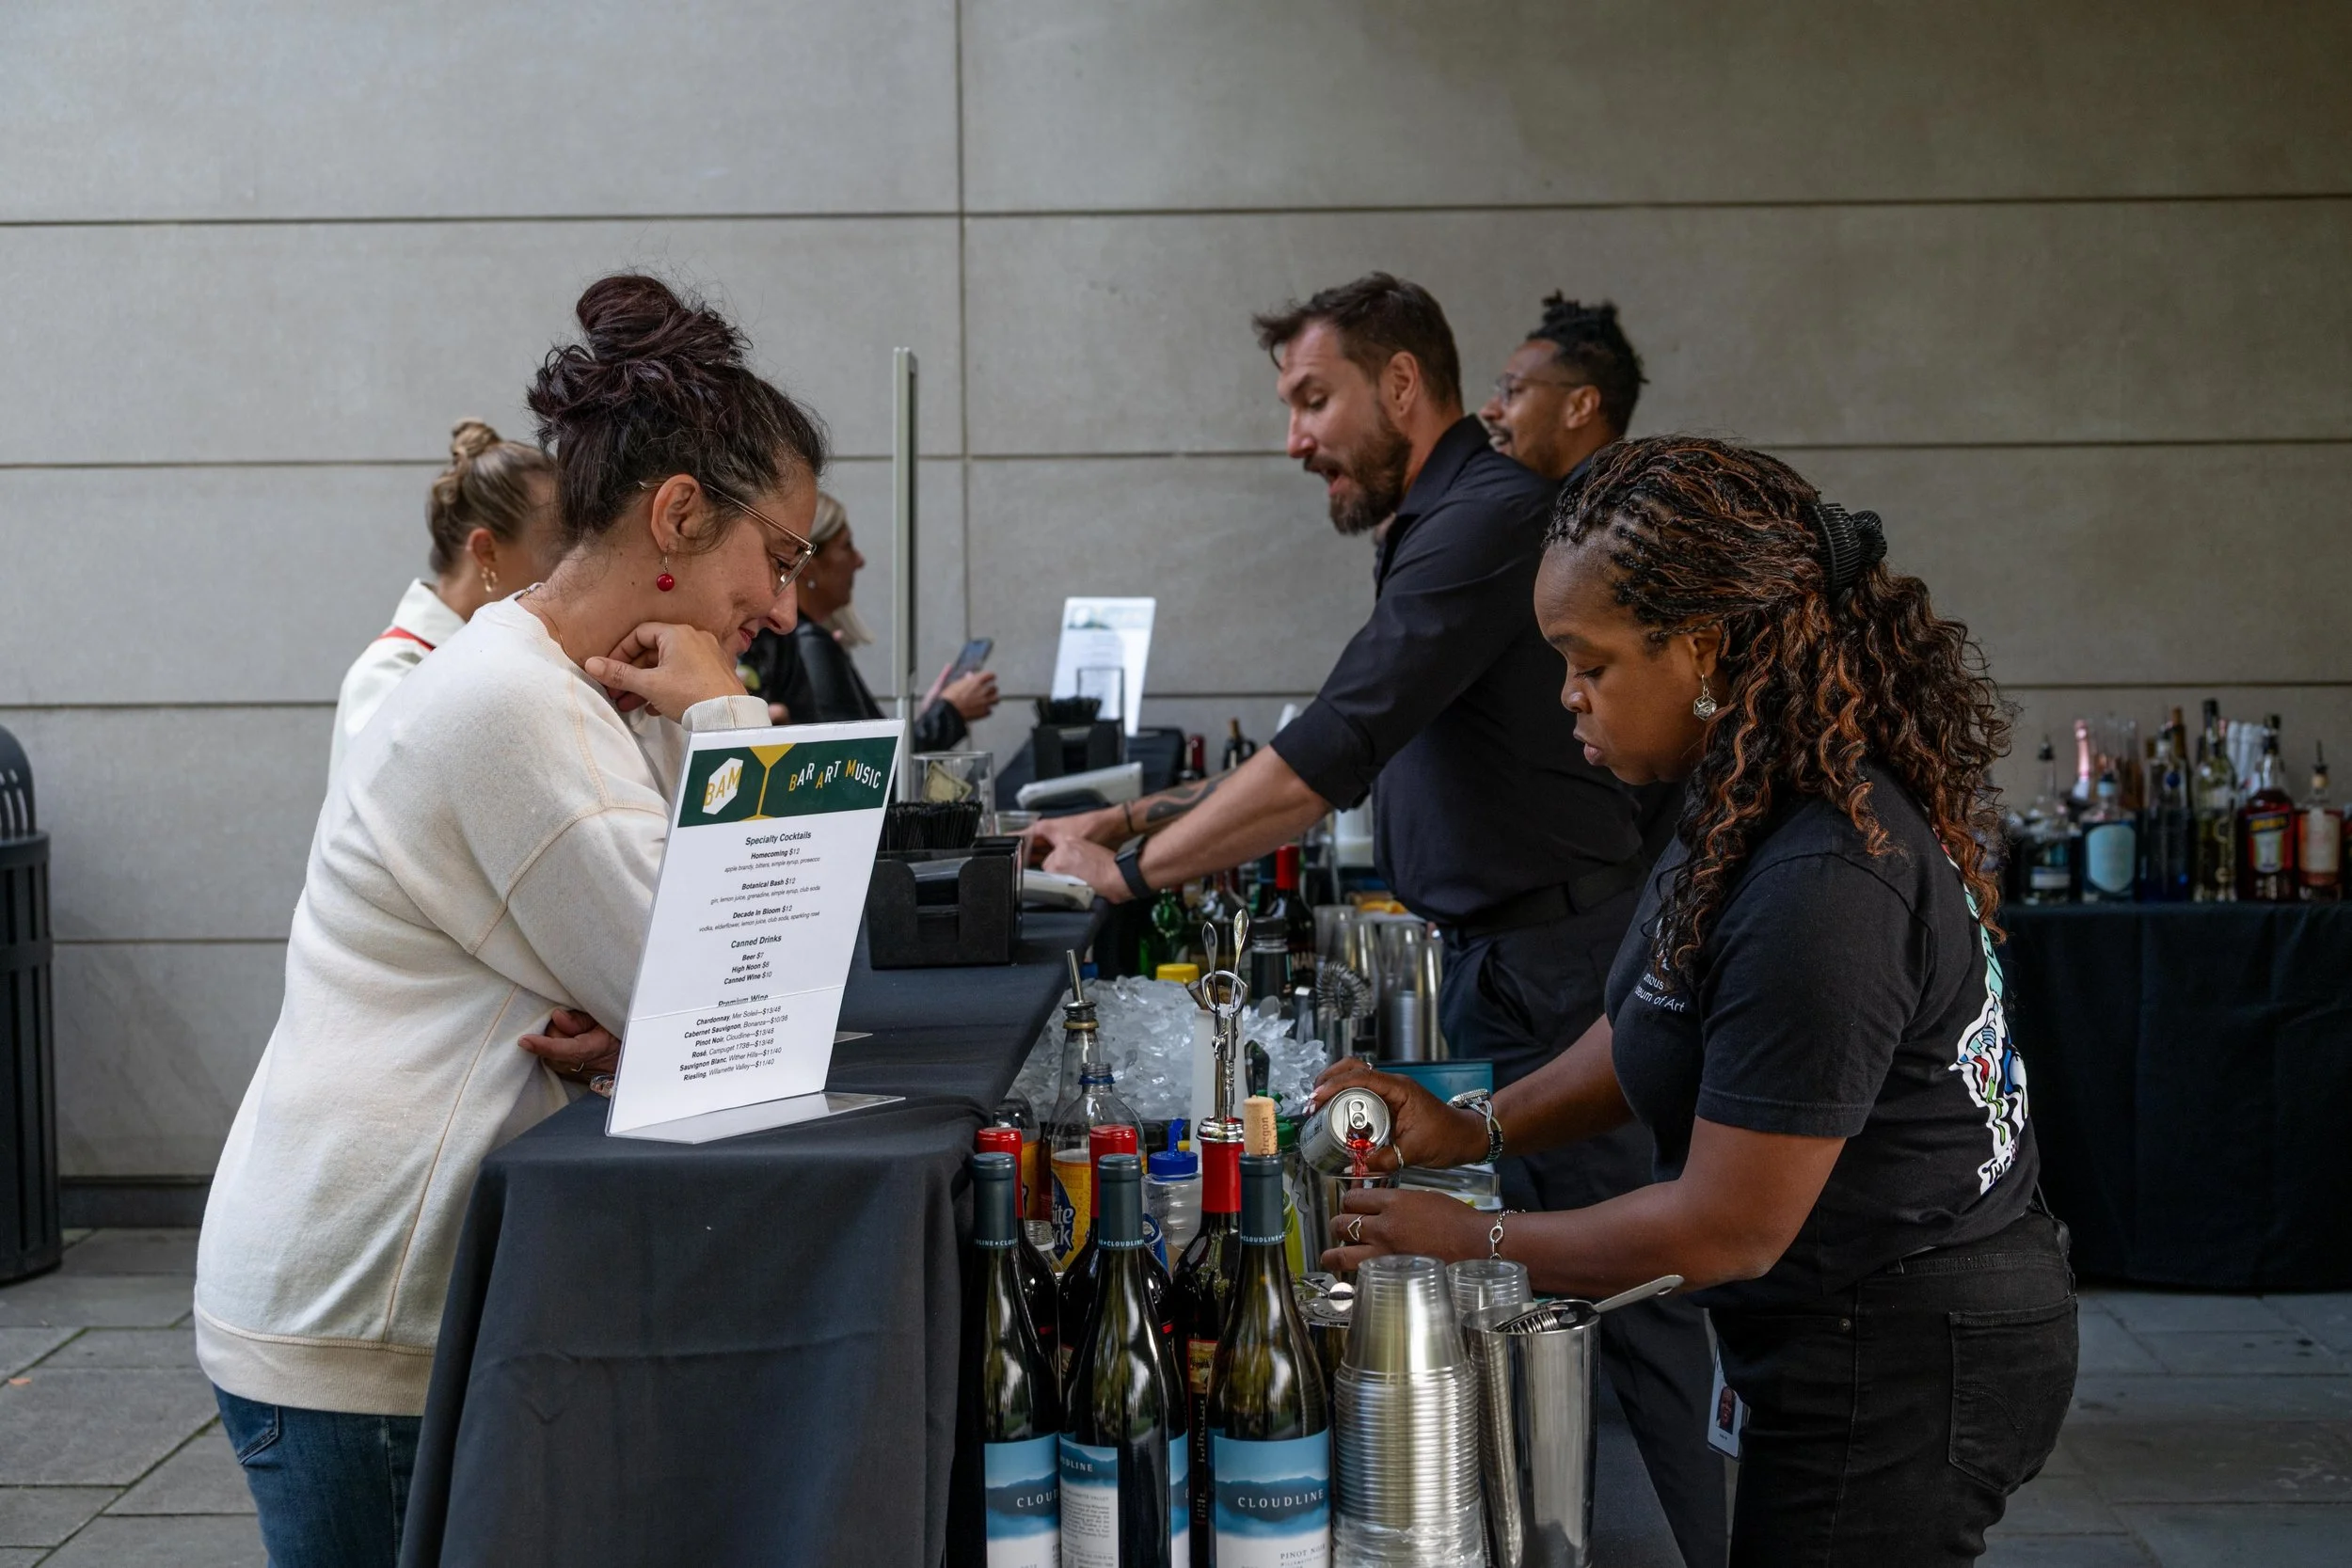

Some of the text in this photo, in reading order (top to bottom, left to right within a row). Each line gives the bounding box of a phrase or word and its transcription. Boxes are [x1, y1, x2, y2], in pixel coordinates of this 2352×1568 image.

[789, 760, 882, 792] BAR ART MUSIC
[704, 767, 741, 806] BAM
[745, 832, 811, 847] Specialty Cocktails
[751, 849, 787, 860] Homecoming
[742, 881, 769, 890] Botanical
[731, 935, 781, 948] Canned Drinks
[742, 953, 755, 961] Beer
[724, 976, 745, 985] Canned
[1654, 996, 1667, 1006] of
[1664, 999, 1685, 1012] Art
[685, 1028, 710, 1038] Cabernet
[711, 1023, 741, 1034] Sauvignon,
[695, 1038, 710, 1047] Pinot
[680, 1061, 709, 1071] Sauvignon
[1261, 1117, 1271, 1155] Oregon
[1053, 1204, 1073, 1225] ite
[1238, 1489, 1325, 1509] CLOUDLINE
[1280, 1550, 1307, 1559] PINOT
